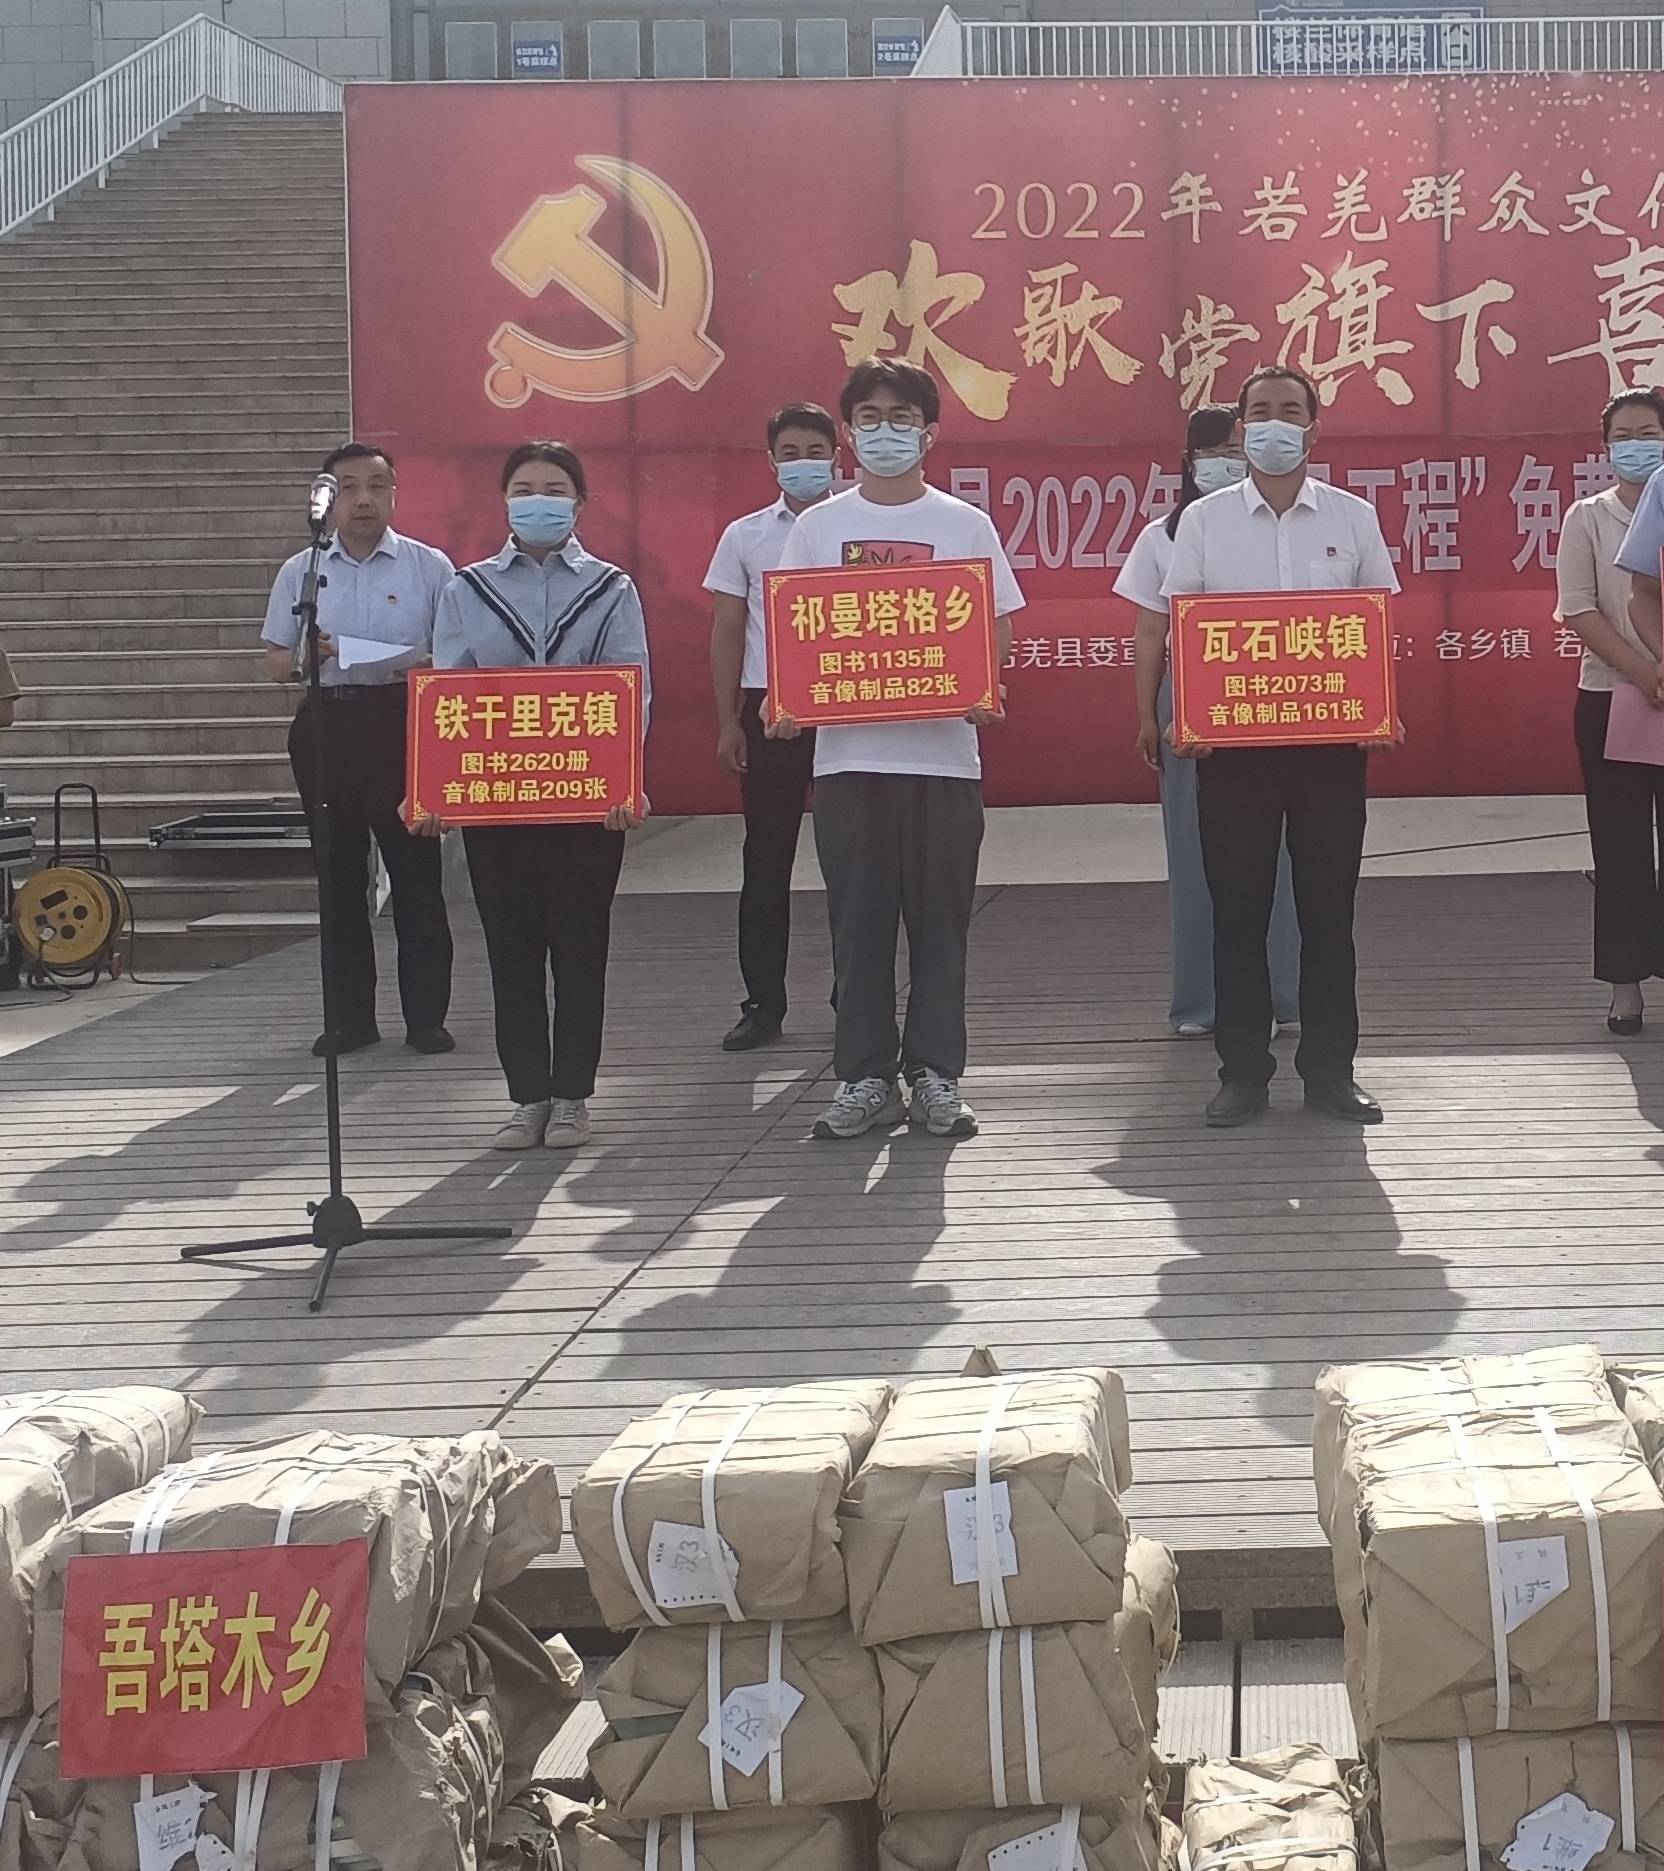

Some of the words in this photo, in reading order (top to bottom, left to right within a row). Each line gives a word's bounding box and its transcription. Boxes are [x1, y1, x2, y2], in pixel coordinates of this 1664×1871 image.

[790, 585, 973, 641] 祁曼塔格乡
[1197, 614, 1369, 663] 瓦石峡镇
[818, 646, 946, 676] 图书1135册
[808, 673, 959, 705] 音像制品82张
[1224, 672, 1347, 698] 图书2073册
[434, 691, 619, 741] 铁干里克镇
[1208, 699, 1365, 726] 音像制品161张
[461, 750, 590, 775] 图书2620册
[441, 777, 608, 804] 音像制品209张
[98, 1587, 333, 1716] 吾塔木乡
